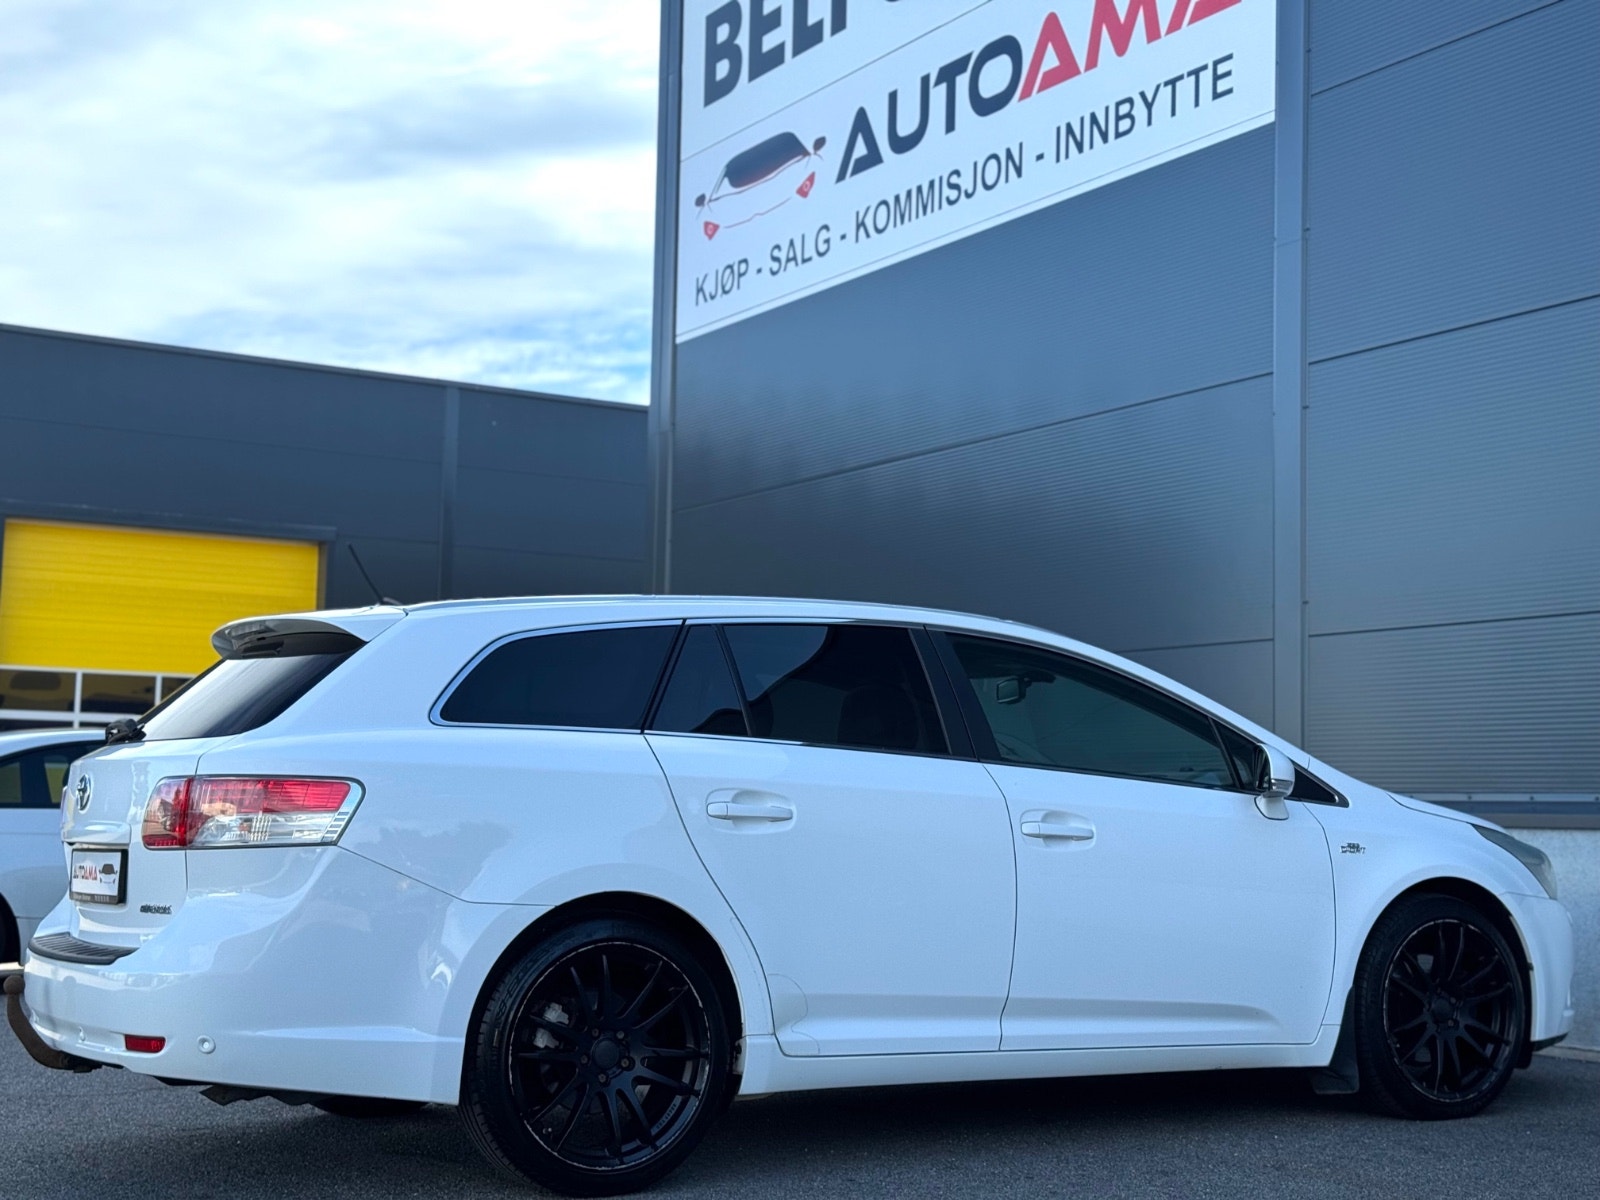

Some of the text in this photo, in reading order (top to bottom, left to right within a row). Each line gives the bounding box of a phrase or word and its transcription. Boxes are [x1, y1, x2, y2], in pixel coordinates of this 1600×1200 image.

[694, 257, 750, 306] KJØP
[769, 223, 831, 277] SALG
[854, 141, 1024, 244] KOMMISJON
[1055, 52, 1234, 164] INNBYTTE
